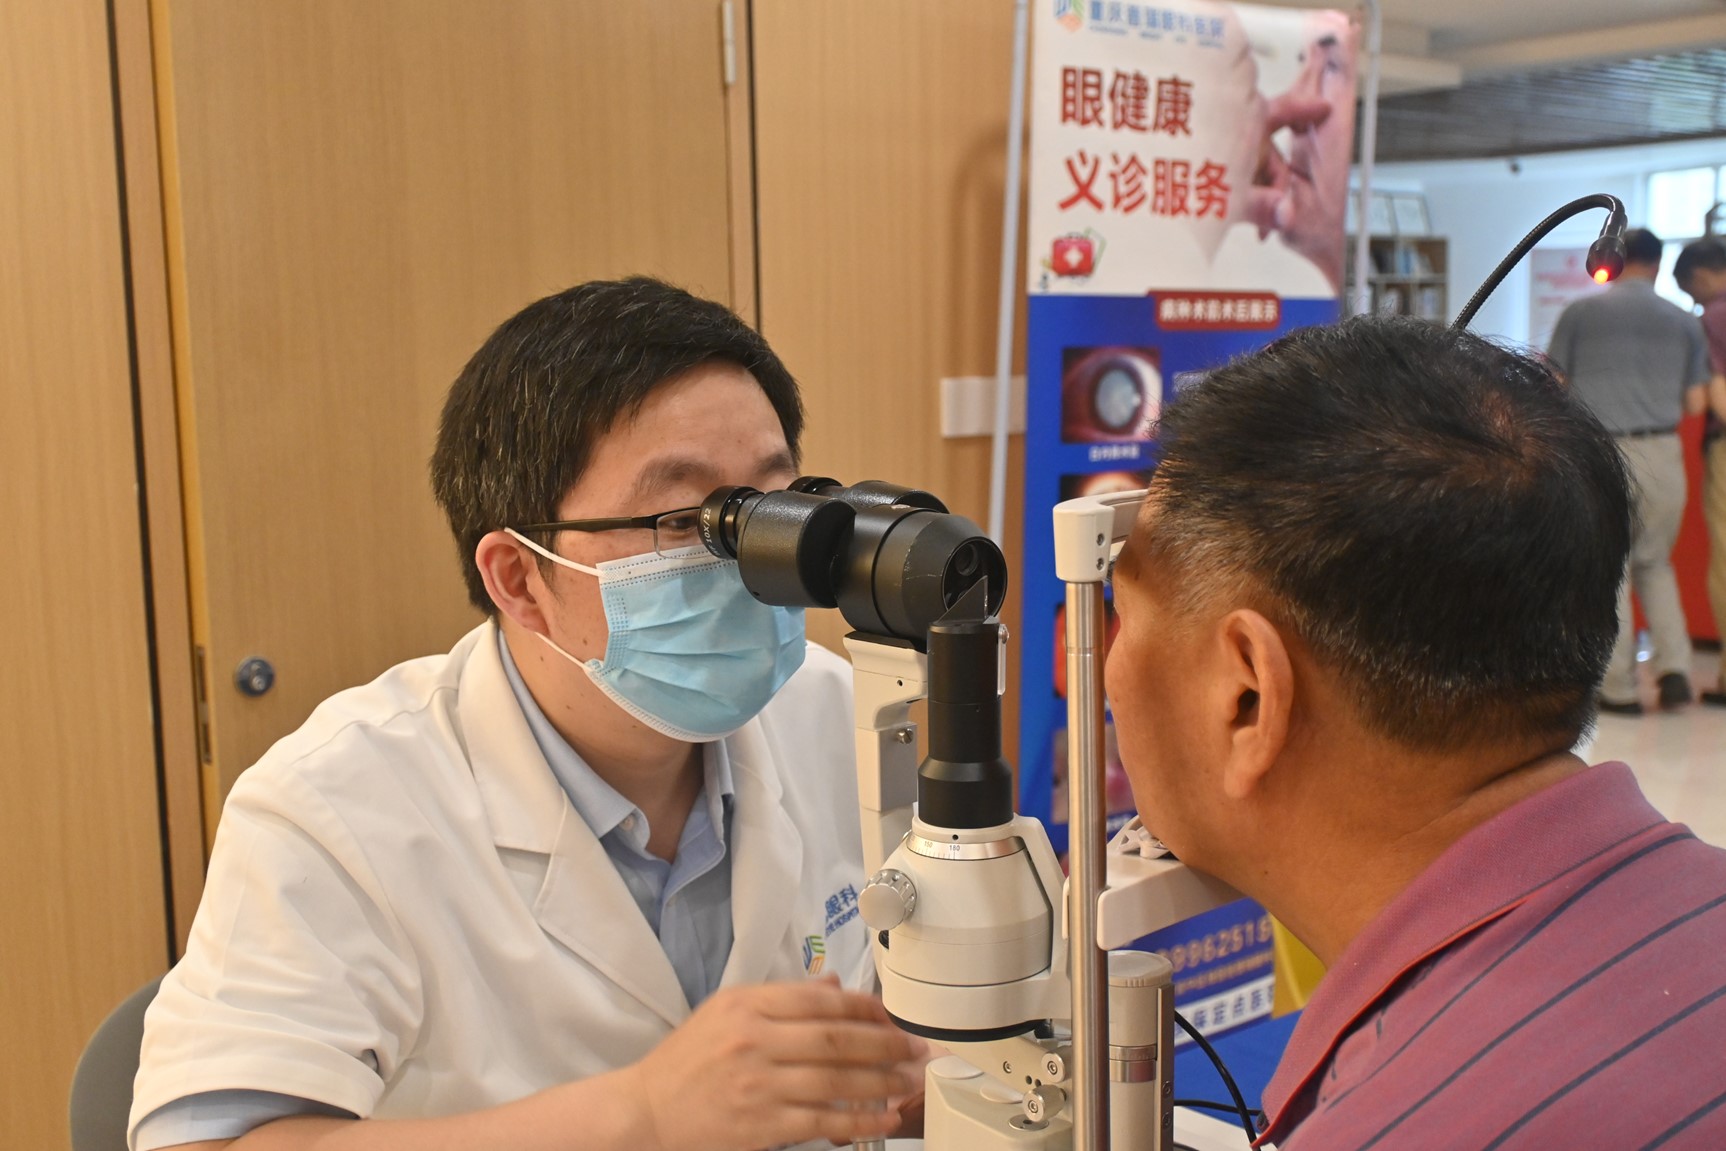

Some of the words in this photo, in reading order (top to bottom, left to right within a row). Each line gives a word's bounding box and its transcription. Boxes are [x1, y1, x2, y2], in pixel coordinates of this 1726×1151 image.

[1062, 67, 1193, 136] 眼健康
[1059, 150, 1231, 219] 义诊服务
[949, 844, 960, 852] 180
[825, 883, 858, 921] 眼科
